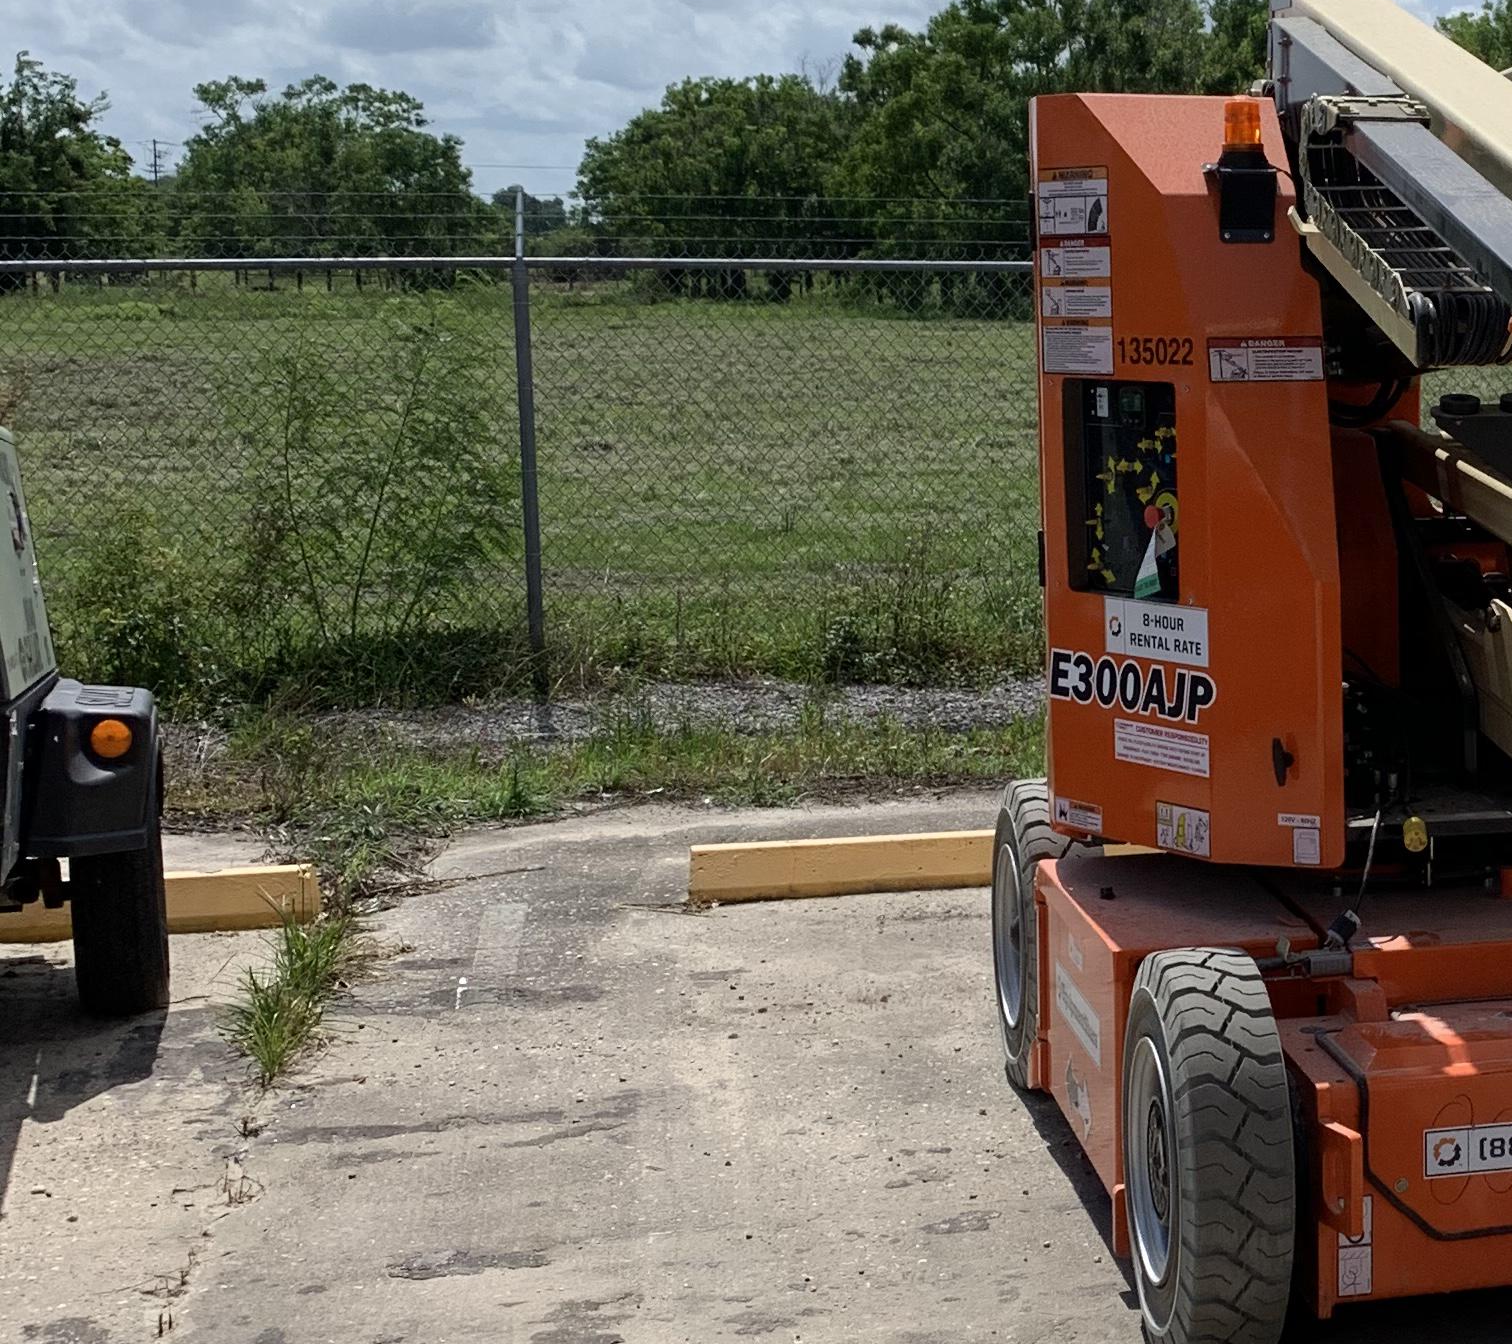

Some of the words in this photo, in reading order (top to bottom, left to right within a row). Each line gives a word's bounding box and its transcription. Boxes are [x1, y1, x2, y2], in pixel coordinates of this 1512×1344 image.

[1117, 337, 1194, 365] 135022
[1247, 339, 1285, 347] DANGER
[1143, 613, 1184, 632] 8-HOUR
[1130, 632, 1170, 652] RENTAL
[1174, 639, 1202, 656] RATE
[1050, 649, 1216, 723] E300AJP
